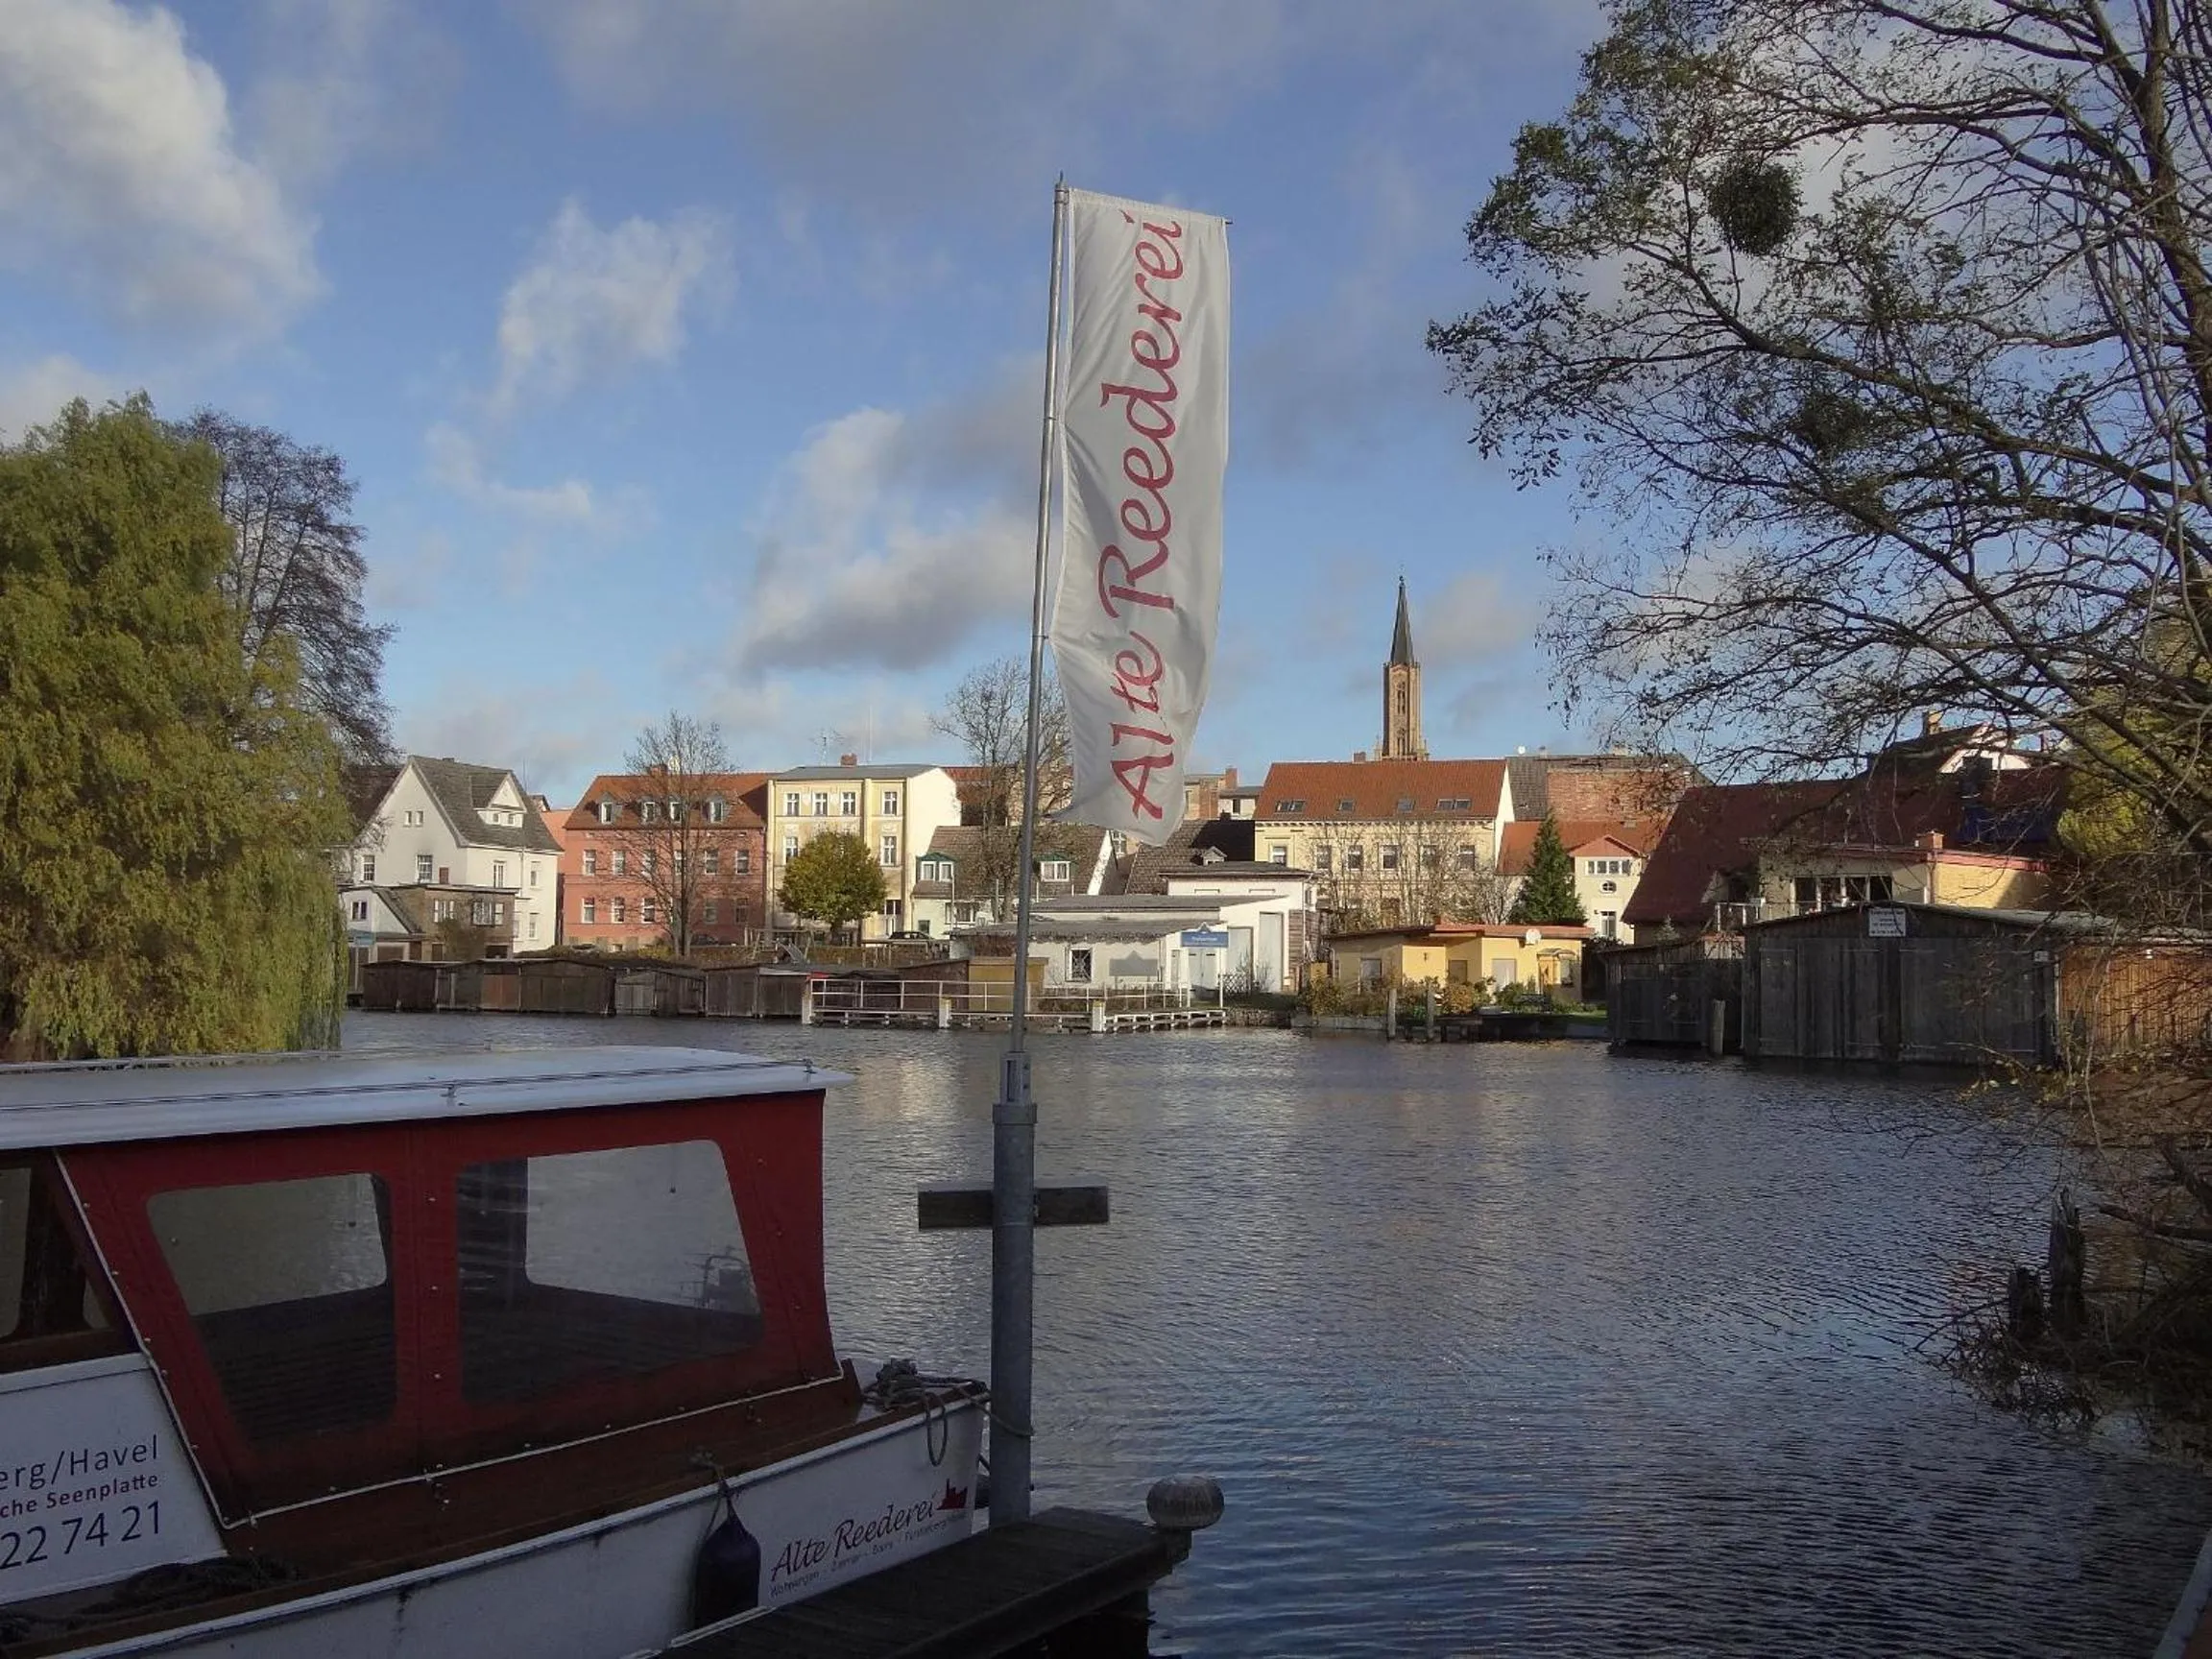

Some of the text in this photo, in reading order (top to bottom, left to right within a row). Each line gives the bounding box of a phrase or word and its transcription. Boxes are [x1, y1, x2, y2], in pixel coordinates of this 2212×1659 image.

[1097, 208, 1185, 819] Alte Reederei
[0, 1474, 158, 1519] che Seenplatte
[0, 1500, 159, 1570] 22 74 21
[771, 1492, 937, 1581] Alte Reederei
